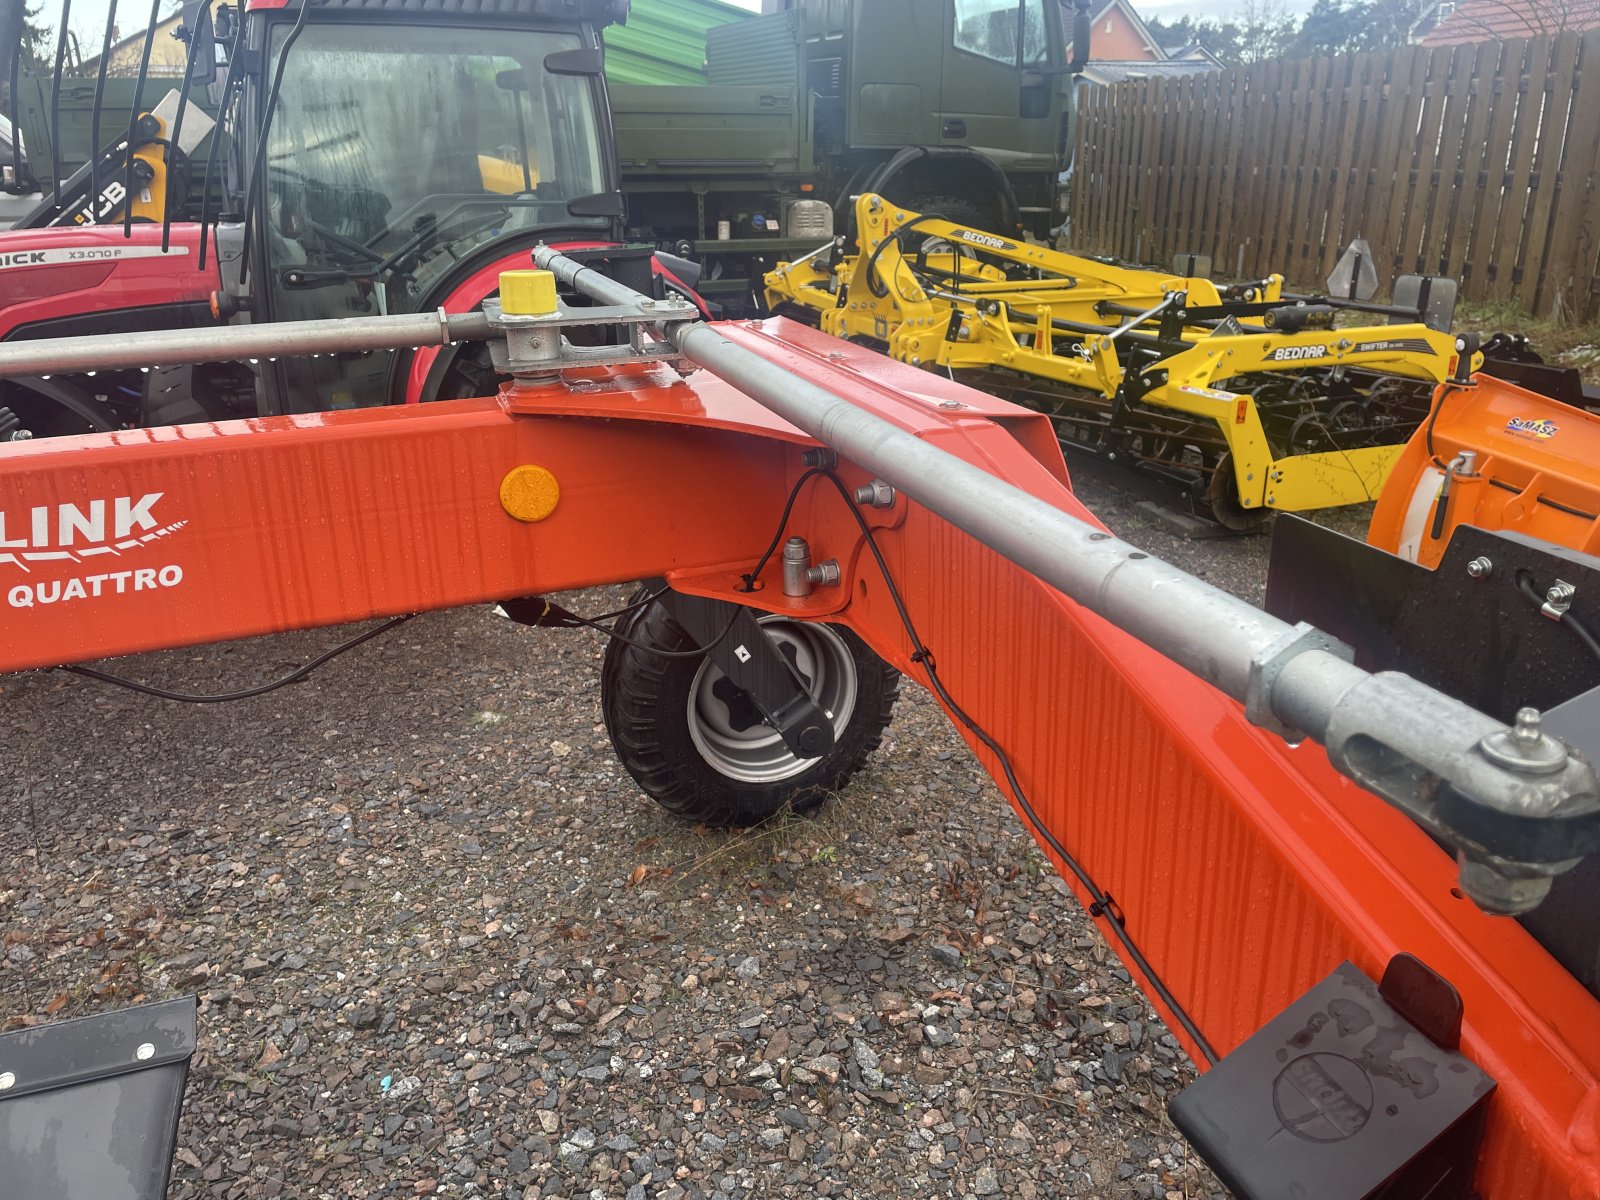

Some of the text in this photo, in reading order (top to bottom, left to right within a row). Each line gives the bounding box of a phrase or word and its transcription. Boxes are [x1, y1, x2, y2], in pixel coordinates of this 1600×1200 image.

[82, 181, 127, 227] JCB
[962, 230, 1005, 249] BEDNAR
[0, 251, 46, 266] ICK
[68, 250, 112, 260] X3.070
[1274, 345, 1326, 361] BEDNAR
[1360, 341, 1389, 352] SWIFTER
[1508, 417, 1558, 436] SaMASZ
[0, 492, 165, 549] LINK
[7, 564, 183, 608] QUATTRO
